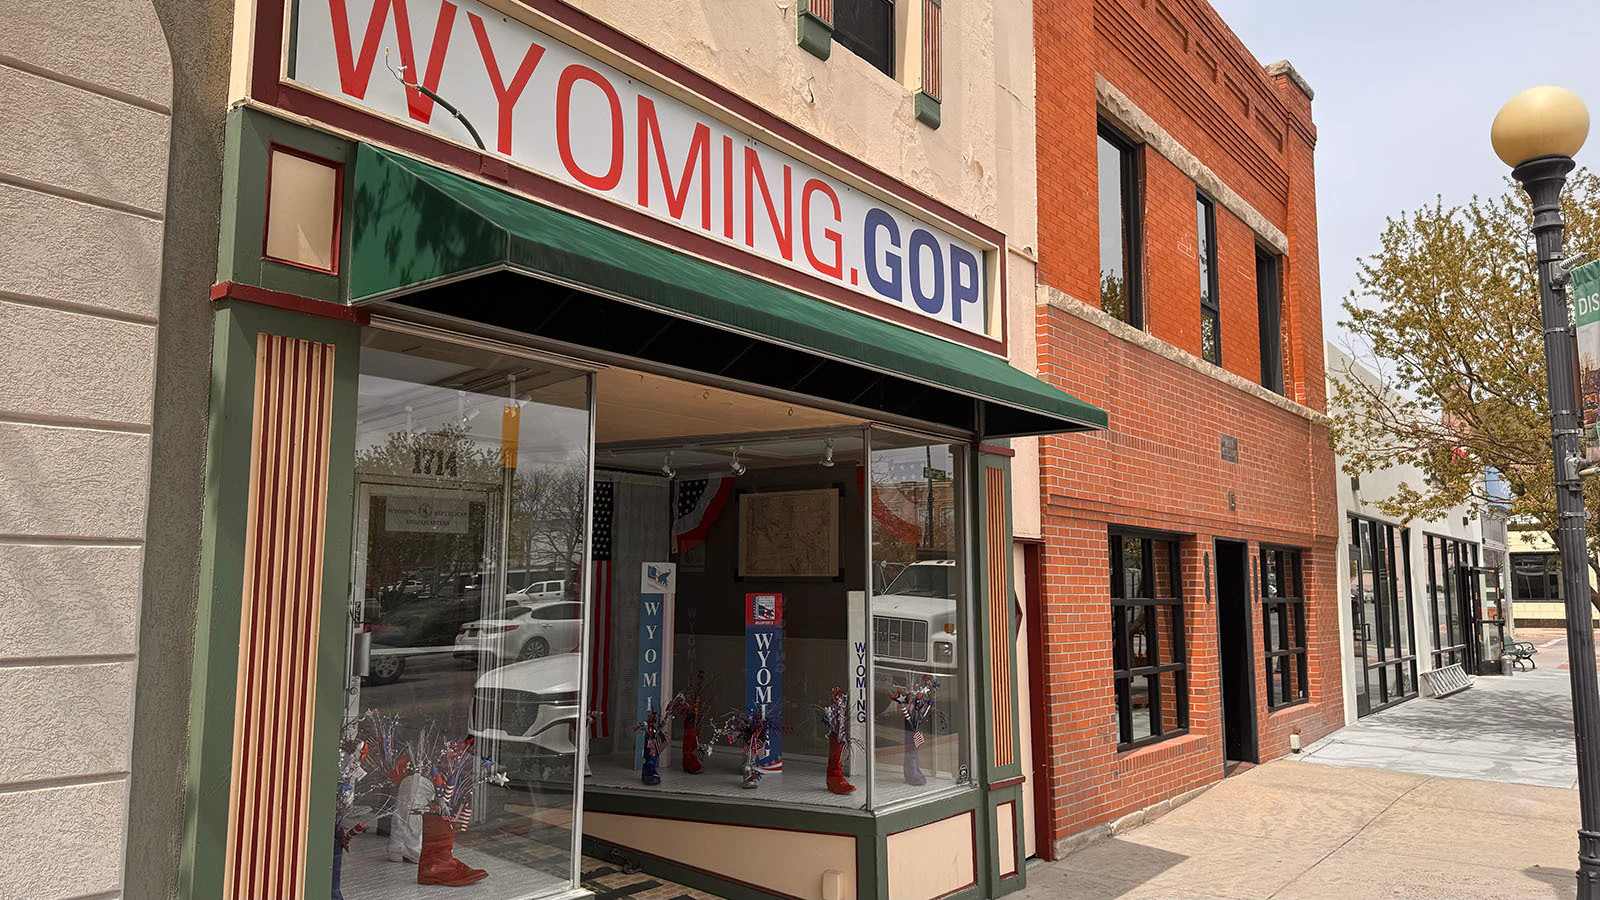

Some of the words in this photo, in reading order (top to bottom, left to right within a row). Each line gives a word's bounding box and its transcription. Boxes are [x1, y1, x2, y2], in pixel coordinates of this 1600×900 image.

[328, 0, 980, 324] WYOMING.GOP
[412, 447, 458, 477] 1714
[642, 601, 660, 712] WYOMI
[854, 641, 867, 724] WYOMING
